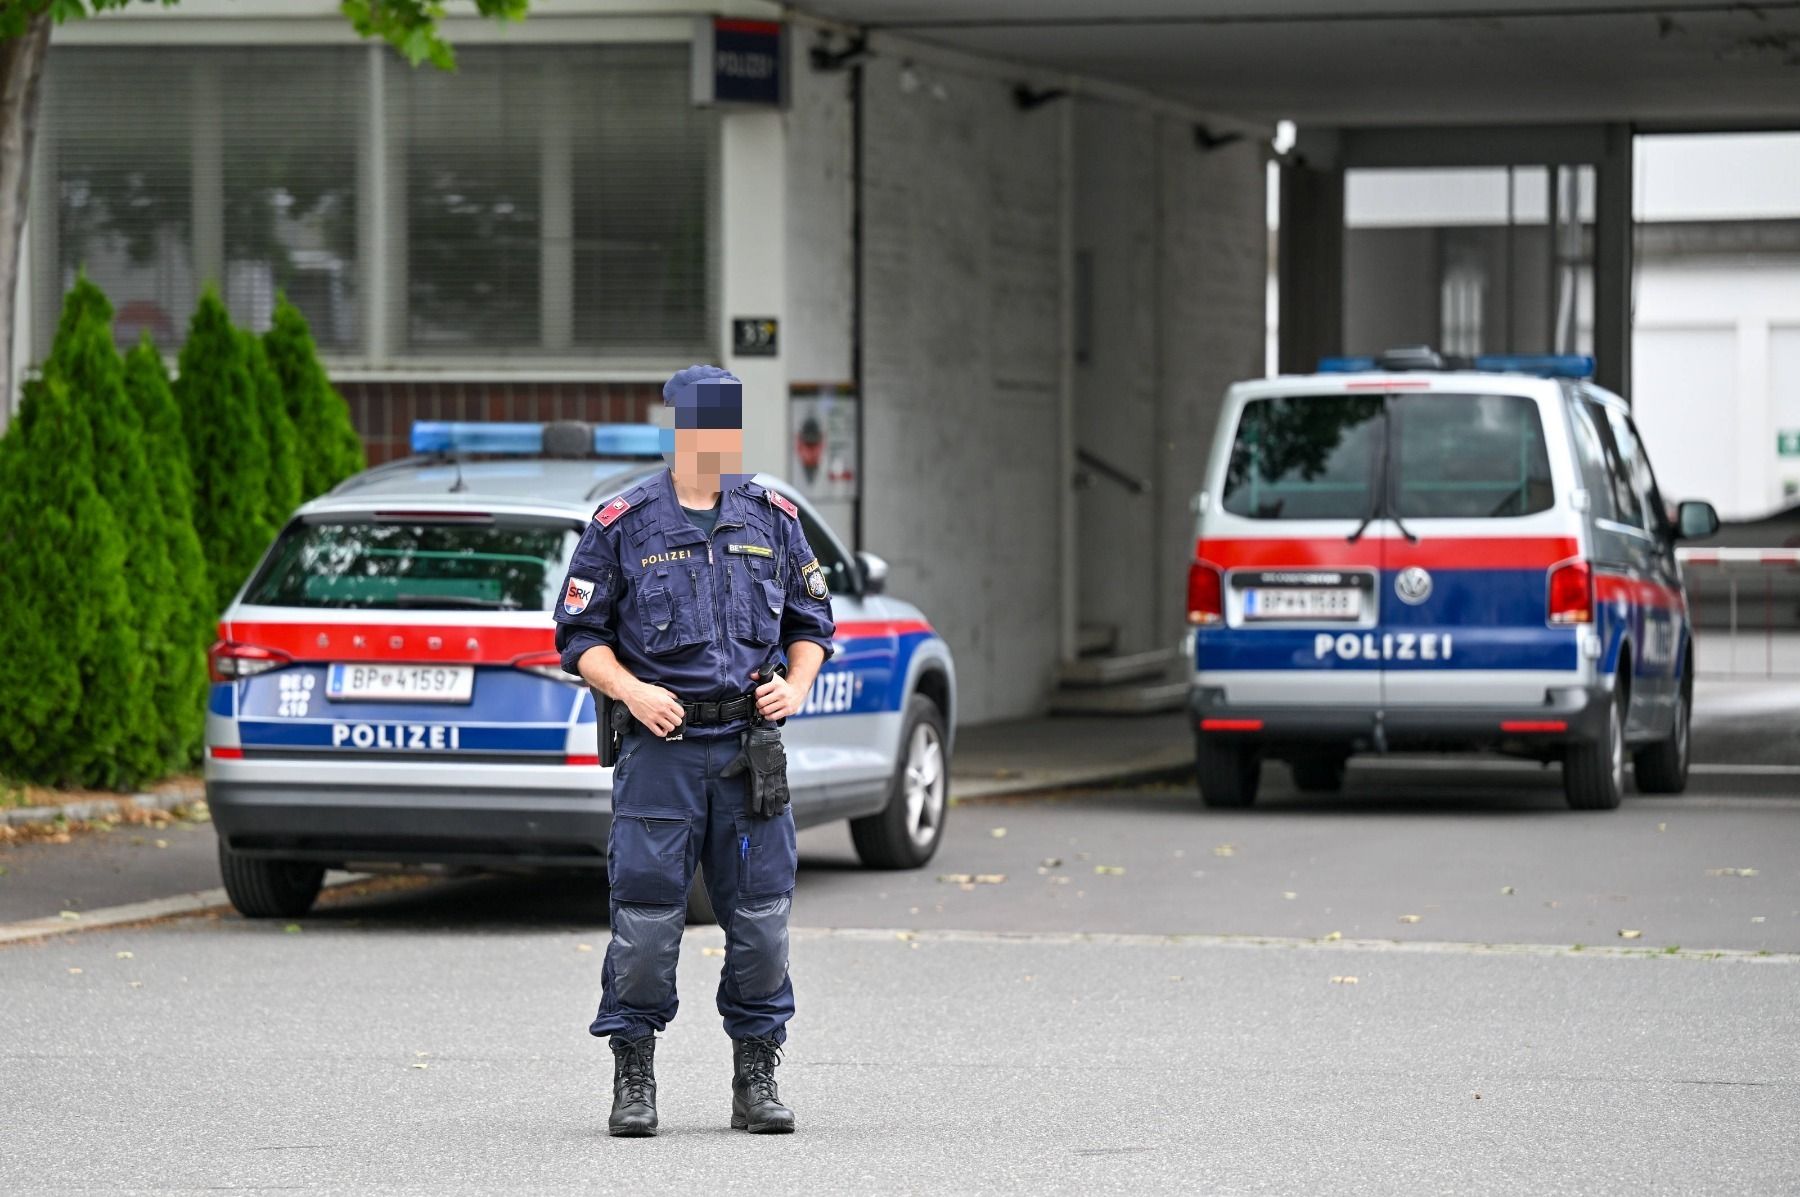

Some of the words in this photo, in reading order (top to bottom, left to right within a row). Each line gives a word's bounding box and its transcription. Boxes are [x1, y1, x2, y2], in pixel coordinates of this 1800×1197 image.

[641, 549, 691, 568] POLIZEI
[568, 586, 590, 600] SRK
[1314, 633, 1452, 660] POLIZEI
[796, 671, 854, 715] LIZEI
[332, 724, 460, 749] POLIZEI
